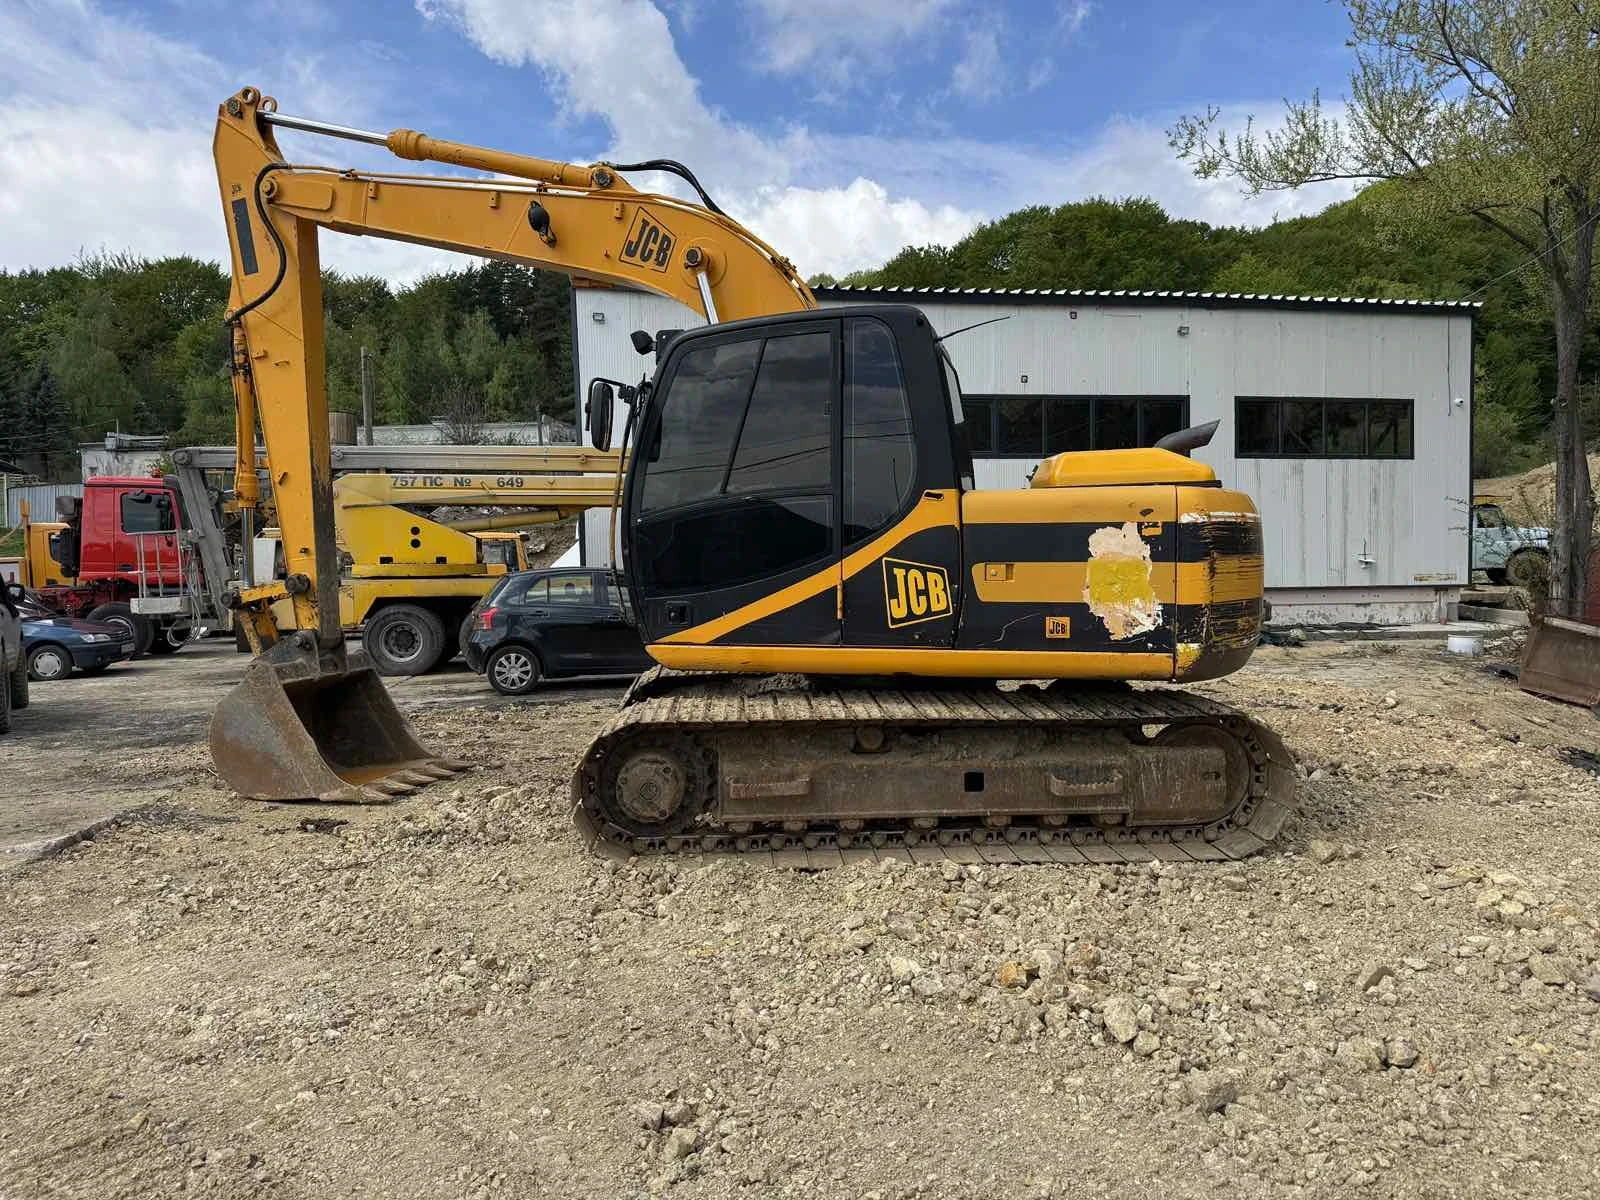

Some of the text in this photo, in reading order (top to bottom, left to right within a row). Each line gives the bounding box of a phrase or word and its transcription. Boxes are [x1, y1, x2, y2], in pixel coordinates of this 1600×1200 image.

[625, 218, 671, 267] JCB
[391, 476, 418, 487] 757
[422, 476, 443, 487] ПС
[496, 477, 524, 488] 649
[890, 567, 947, 619] JCB
[1049, 620, 1066, 635] JCB
